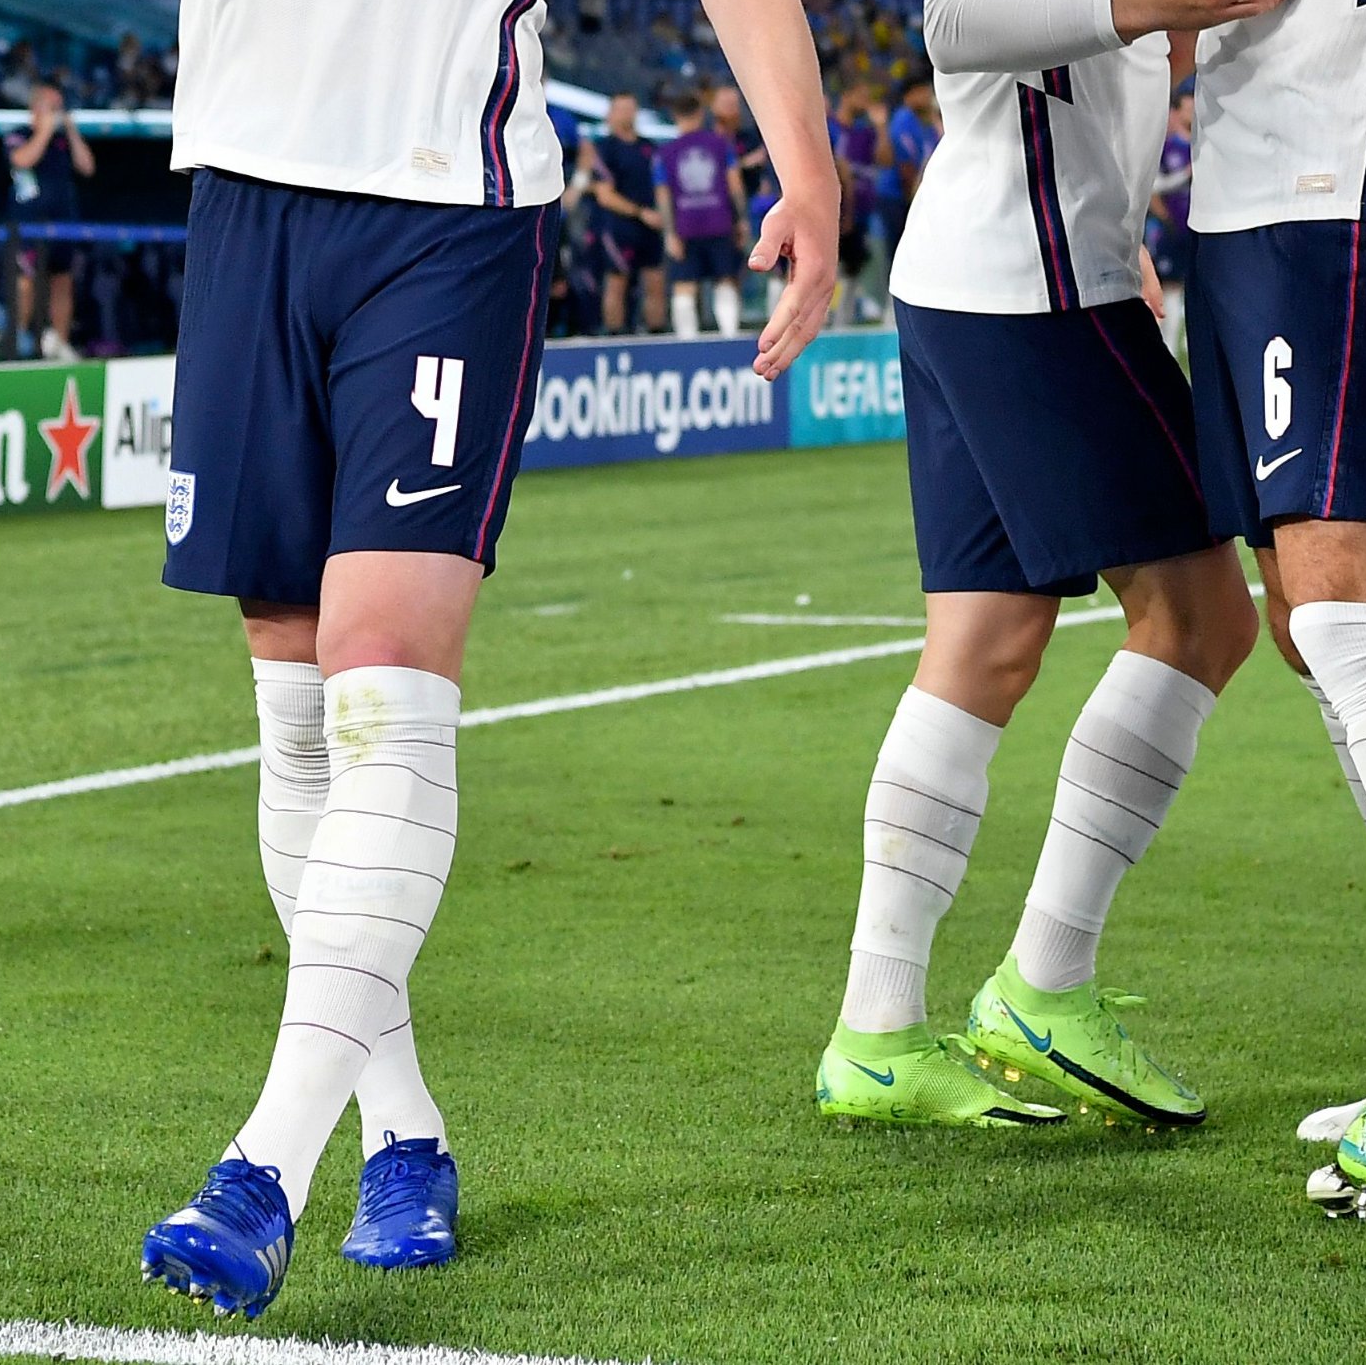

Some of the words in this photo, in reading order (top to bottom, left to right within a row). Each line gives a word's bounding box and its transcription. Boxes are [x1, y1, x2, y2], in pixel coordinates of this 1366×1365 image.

[410, 355, 465, 468] 4
[810, 362, 880, 419] UEFA
[1263, 336, 1293, 440] 6
